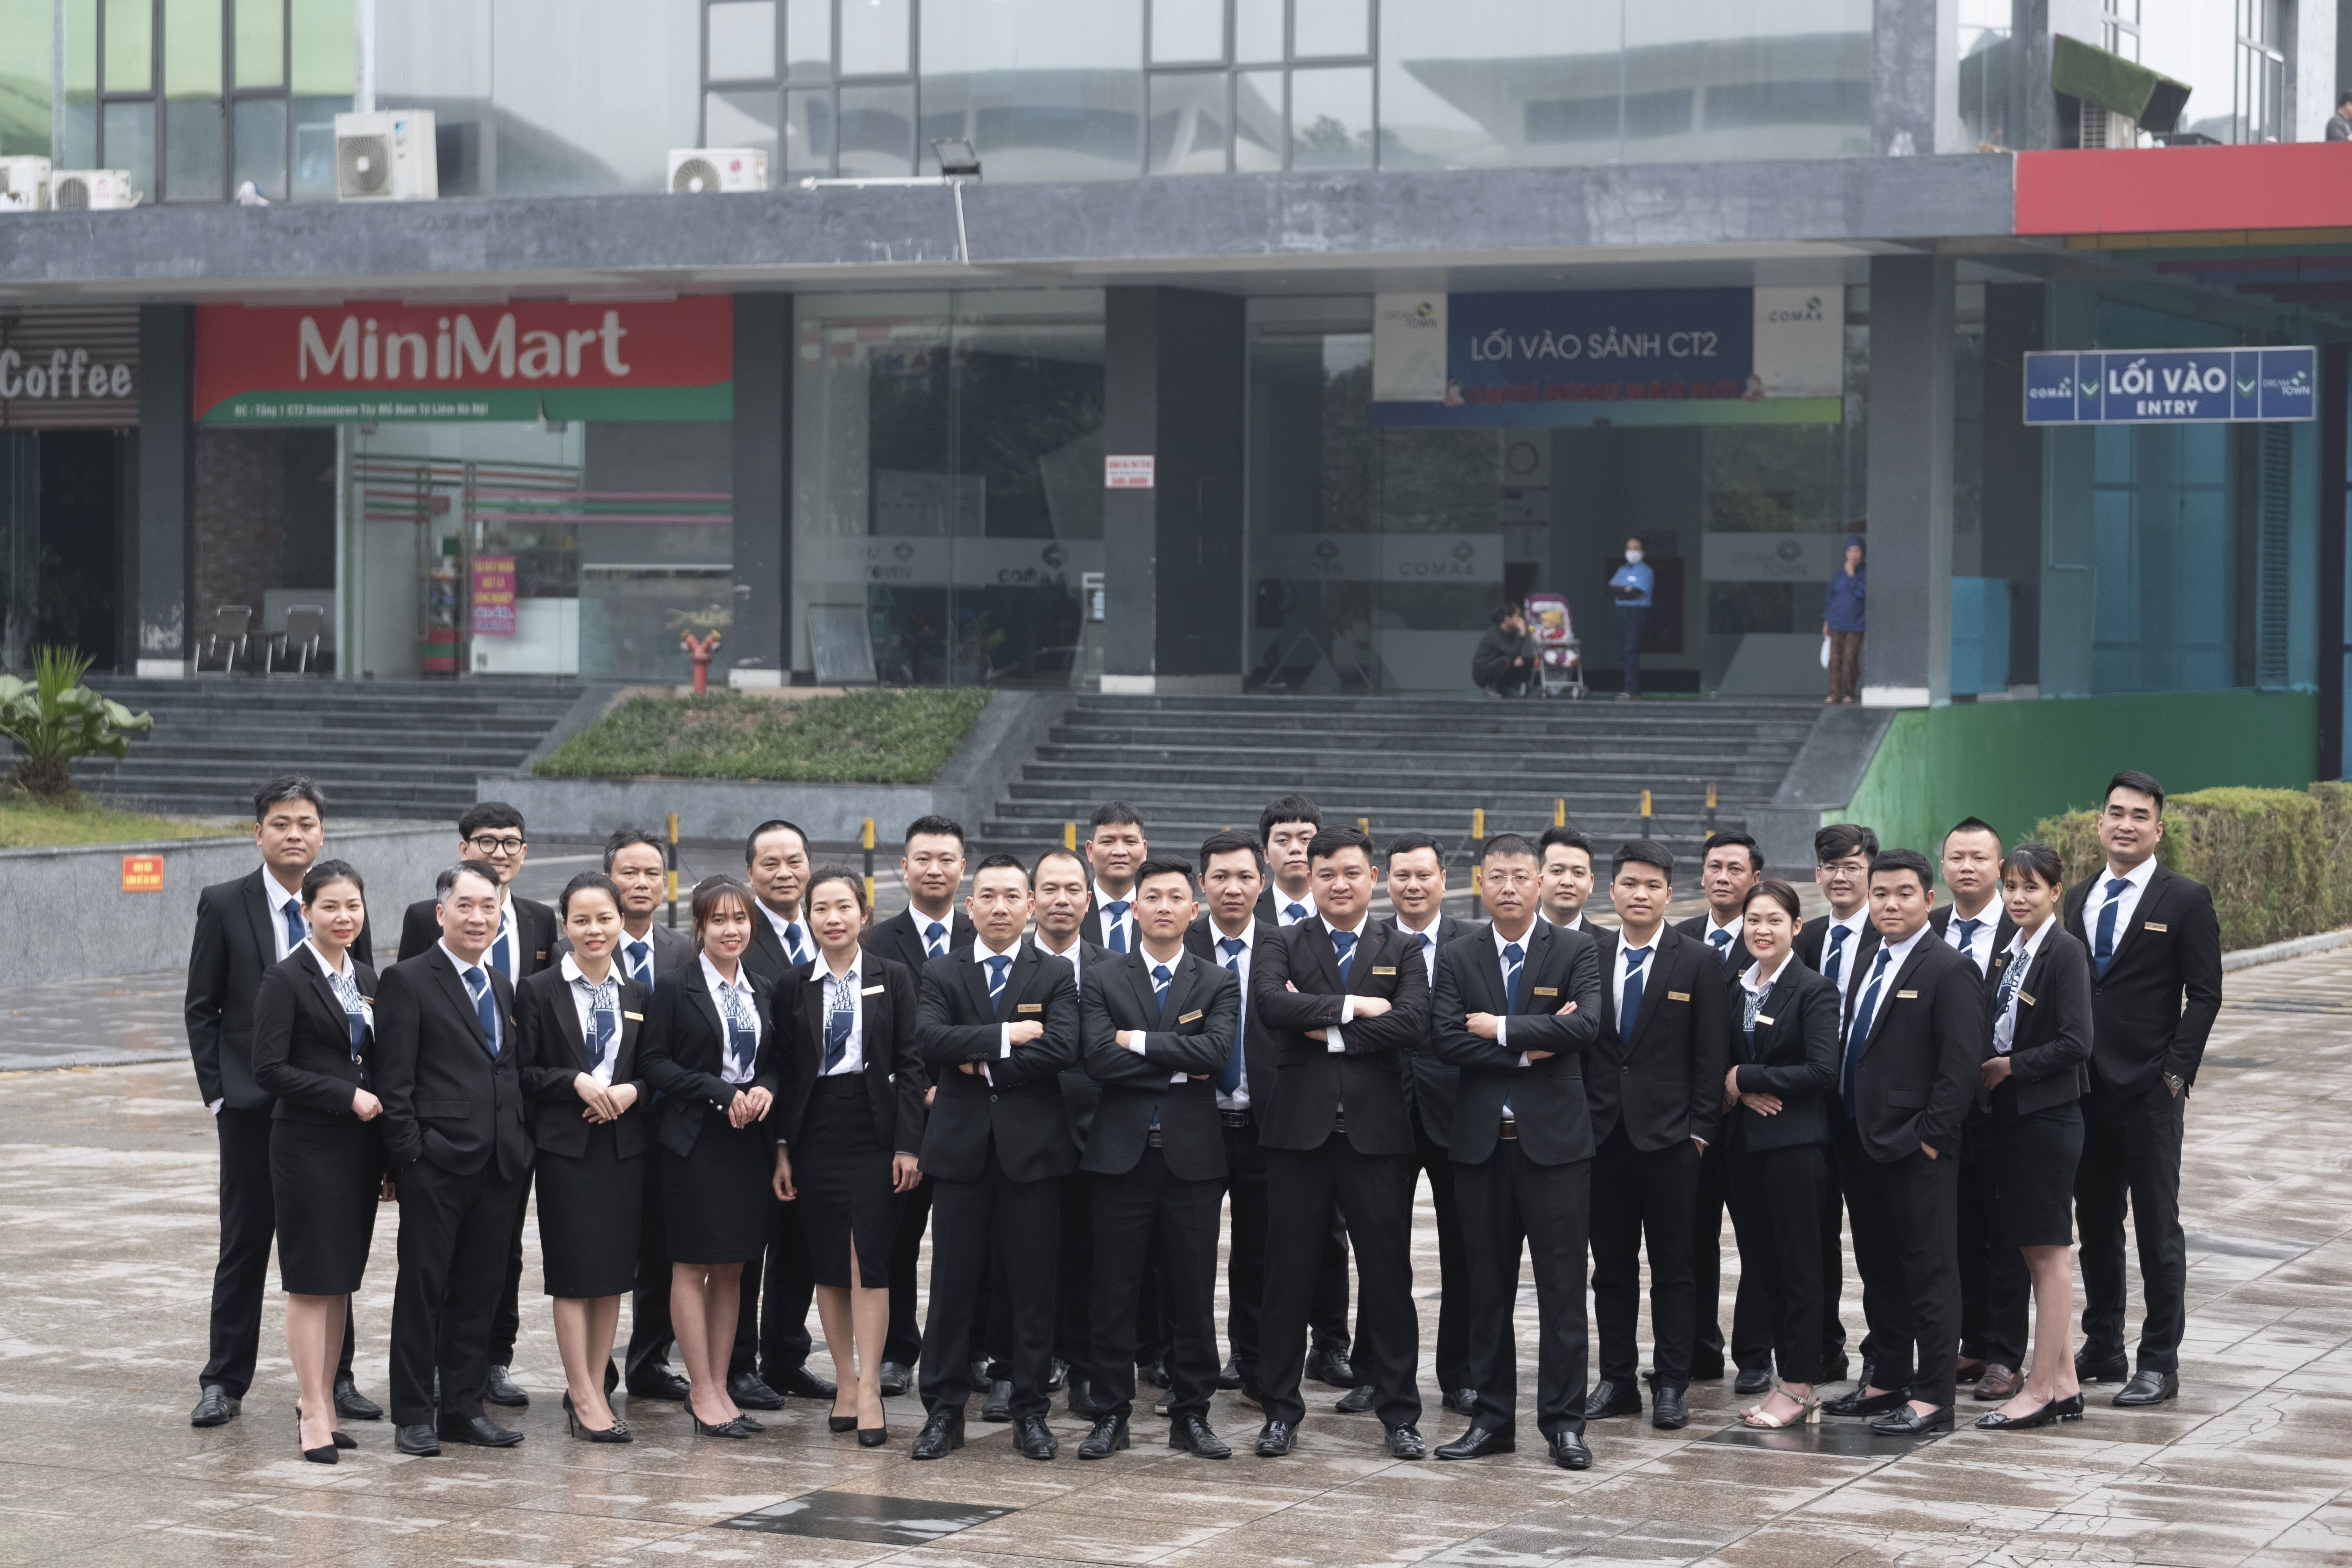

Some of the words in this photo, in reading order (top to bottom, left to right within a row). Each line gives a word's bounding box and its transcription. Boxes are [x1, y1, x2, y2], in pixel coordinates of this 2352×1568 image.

[299, 310, 630, 381] MiniMart
[1471, 328, 1512, 361] LỐI
[1519, 329, 1582, 360] VÀO
[1587, 326, 1661, 360] SẢNH
[1667, 331, 1718, 358] CT2
[0, 348, 133, 398] Coffee
[2109, 358, 2154, 395] LỐI
[2162, 361, 2227, 393] VÀO
[2263, 378, 2290, 388] DREAM
[2282, 385, 2310, 396] TOWN
[2029, 387, 2072, 399] COMA6
[306, 403, 358, 416] Dreamtown
[395, 403, 417, 416] Nam
[2136, 399, 2199, 416] ENTRY
